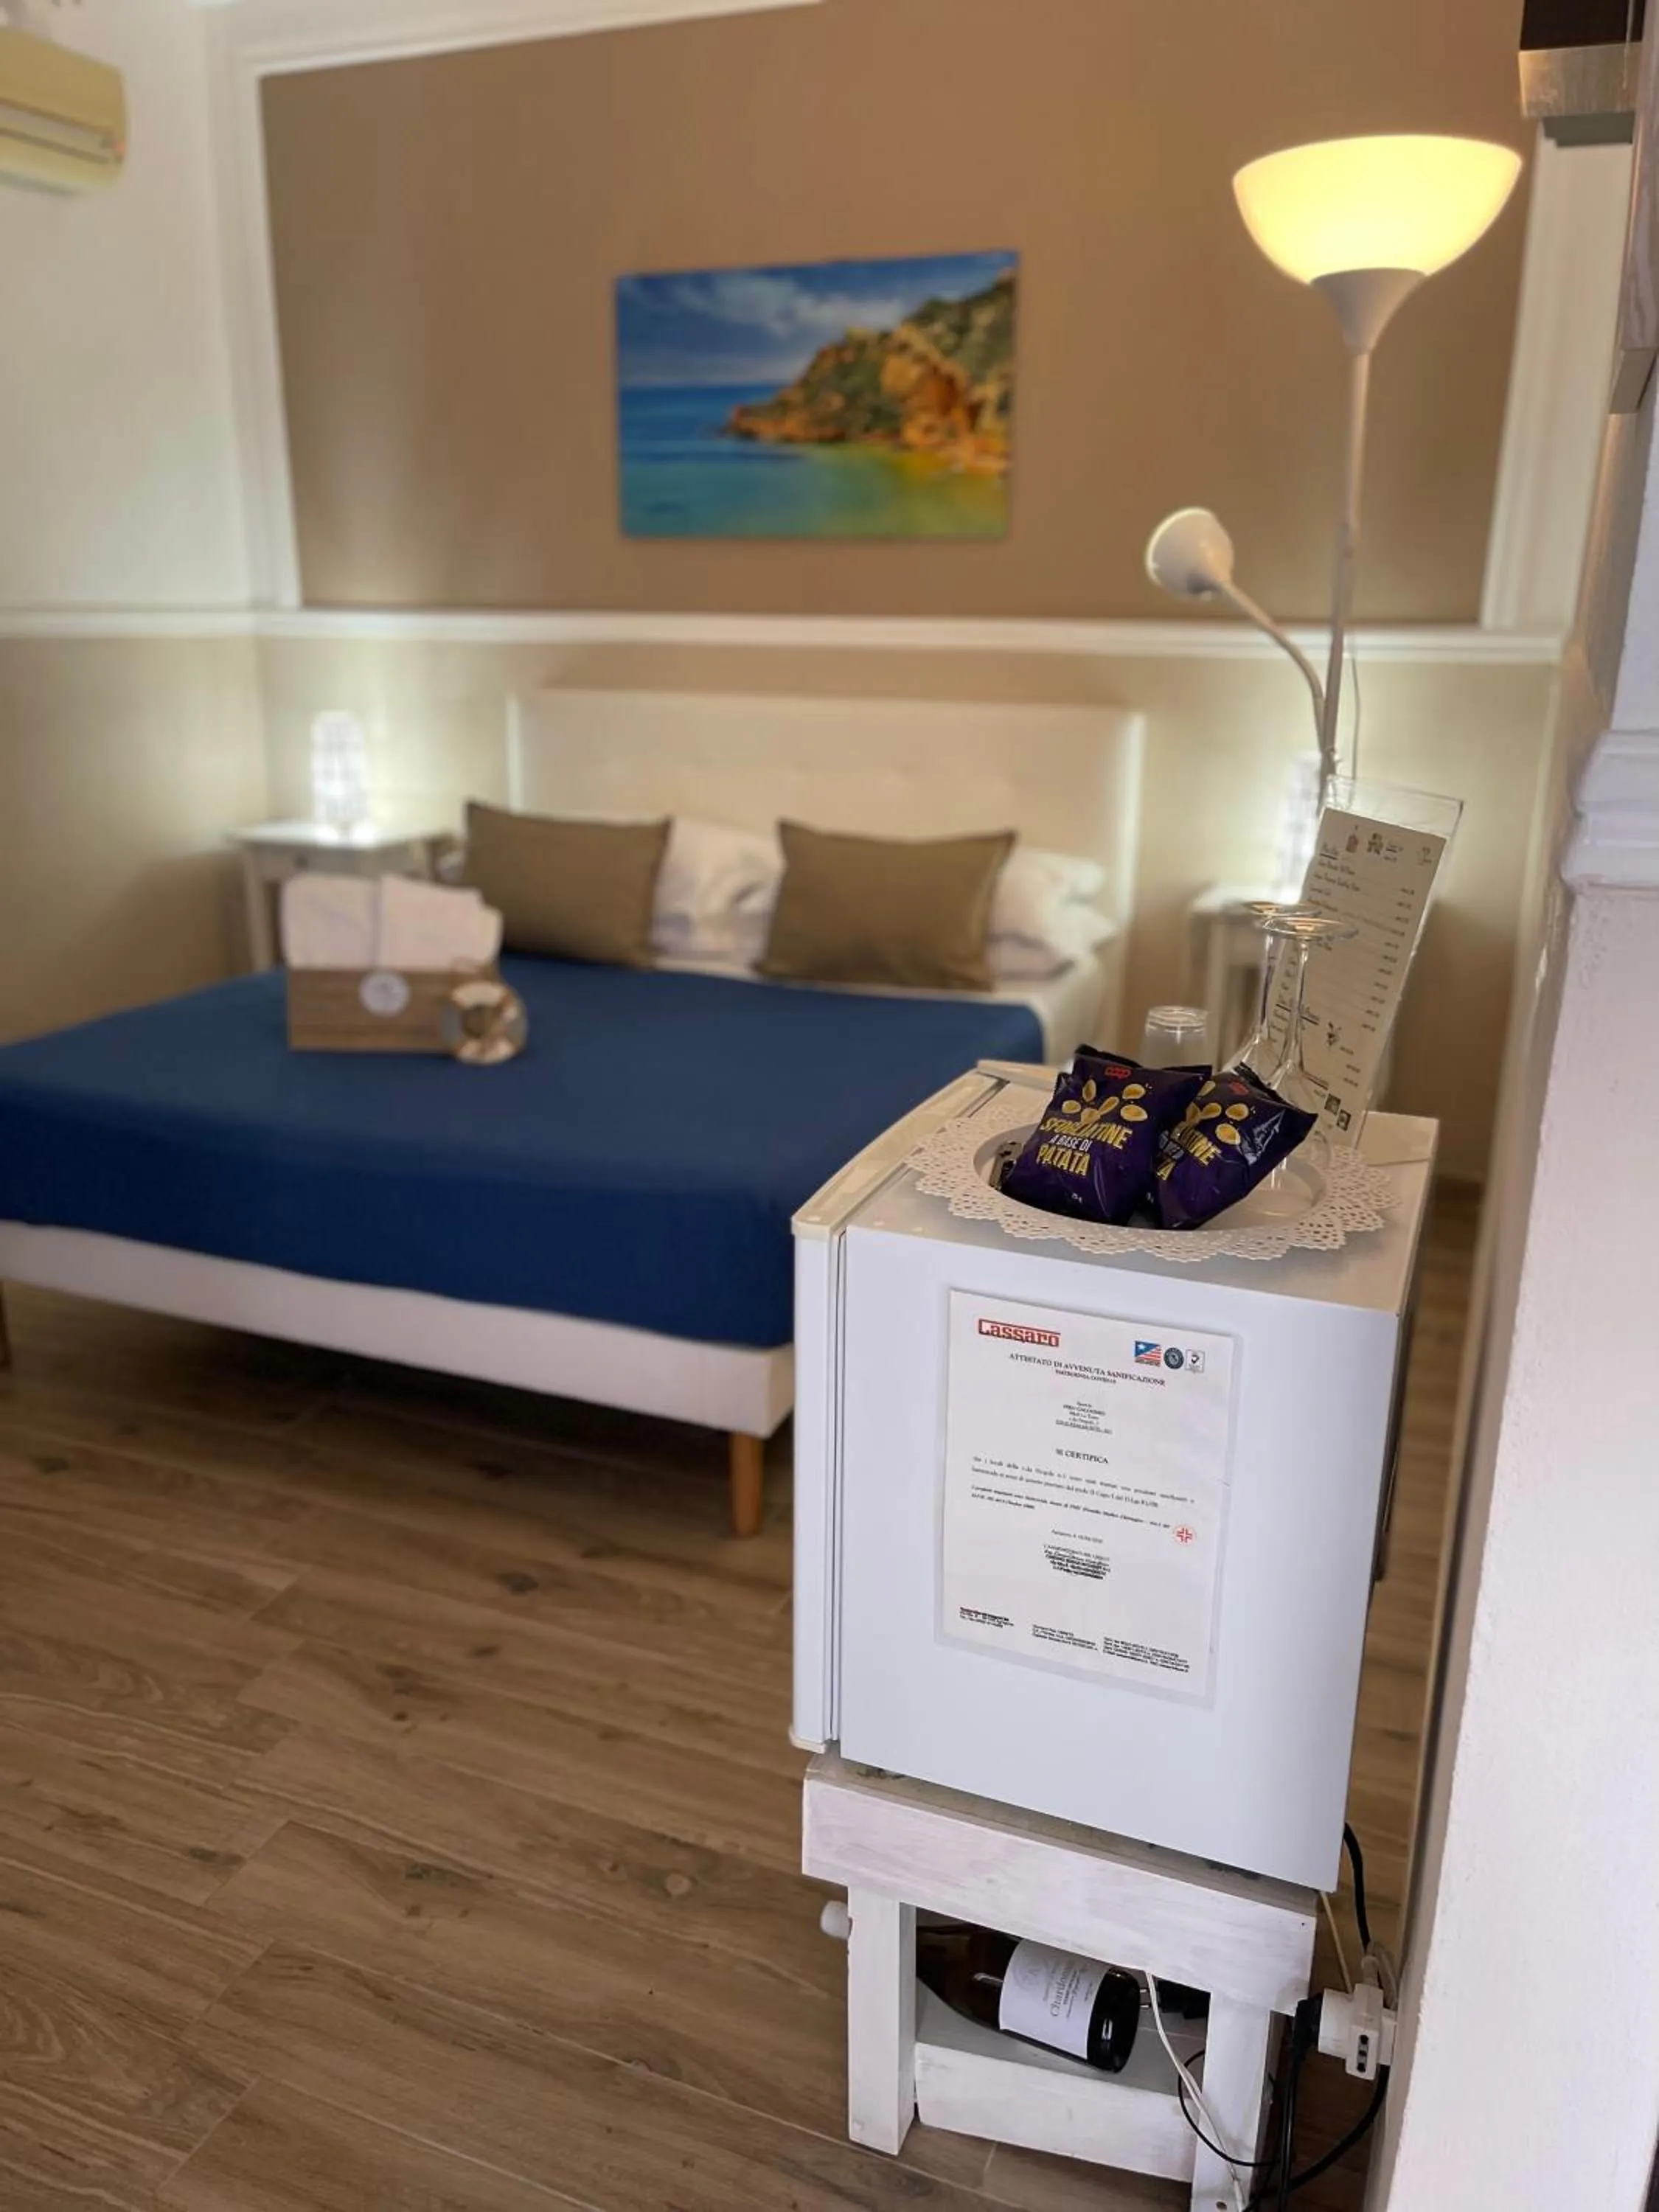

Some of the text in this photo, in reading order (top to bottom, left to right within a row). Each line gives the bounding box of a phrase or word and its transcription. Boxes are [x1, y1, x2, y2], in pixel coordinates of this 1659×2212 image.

[1056, 1135, 1082, 1150] BASE
[1079, 1138, 1093, 1152] DI
[1035, 1143, 1091, 1176] PATATA
[1064, 1450, 1108, 1464] CERTIFICA
